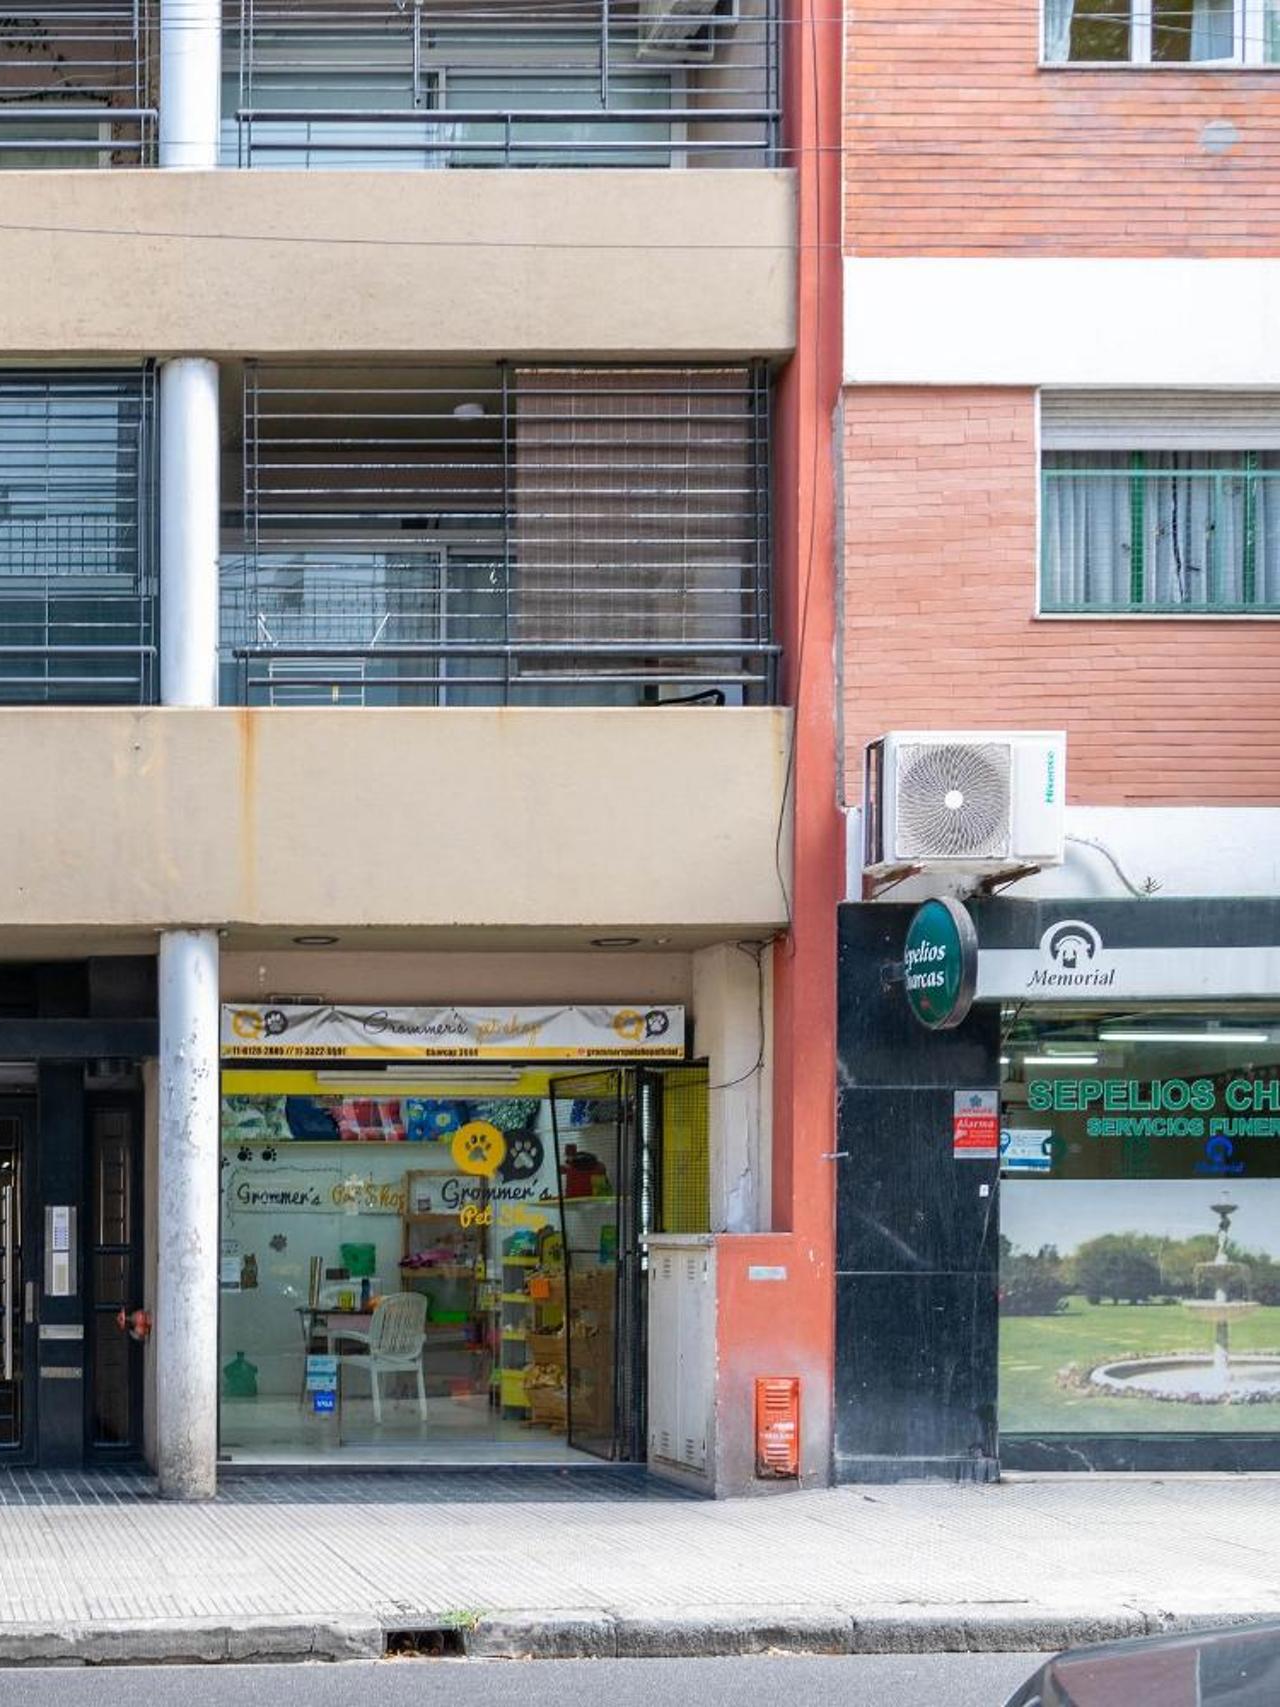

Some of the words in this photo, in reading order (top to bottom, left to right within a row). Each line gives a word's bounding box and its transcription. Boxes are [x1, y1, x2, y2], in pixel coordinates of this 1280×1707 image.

[1027, 968, 1115, 988] Memorial
[1028, 1079, 1216, 1111] SEPELIOS
[1086, 1117, 1205, 1137] SERVICIOS
[441, 1178, 553, 1209] Grommer's
[460, 1204, 491, 1229] Pet
